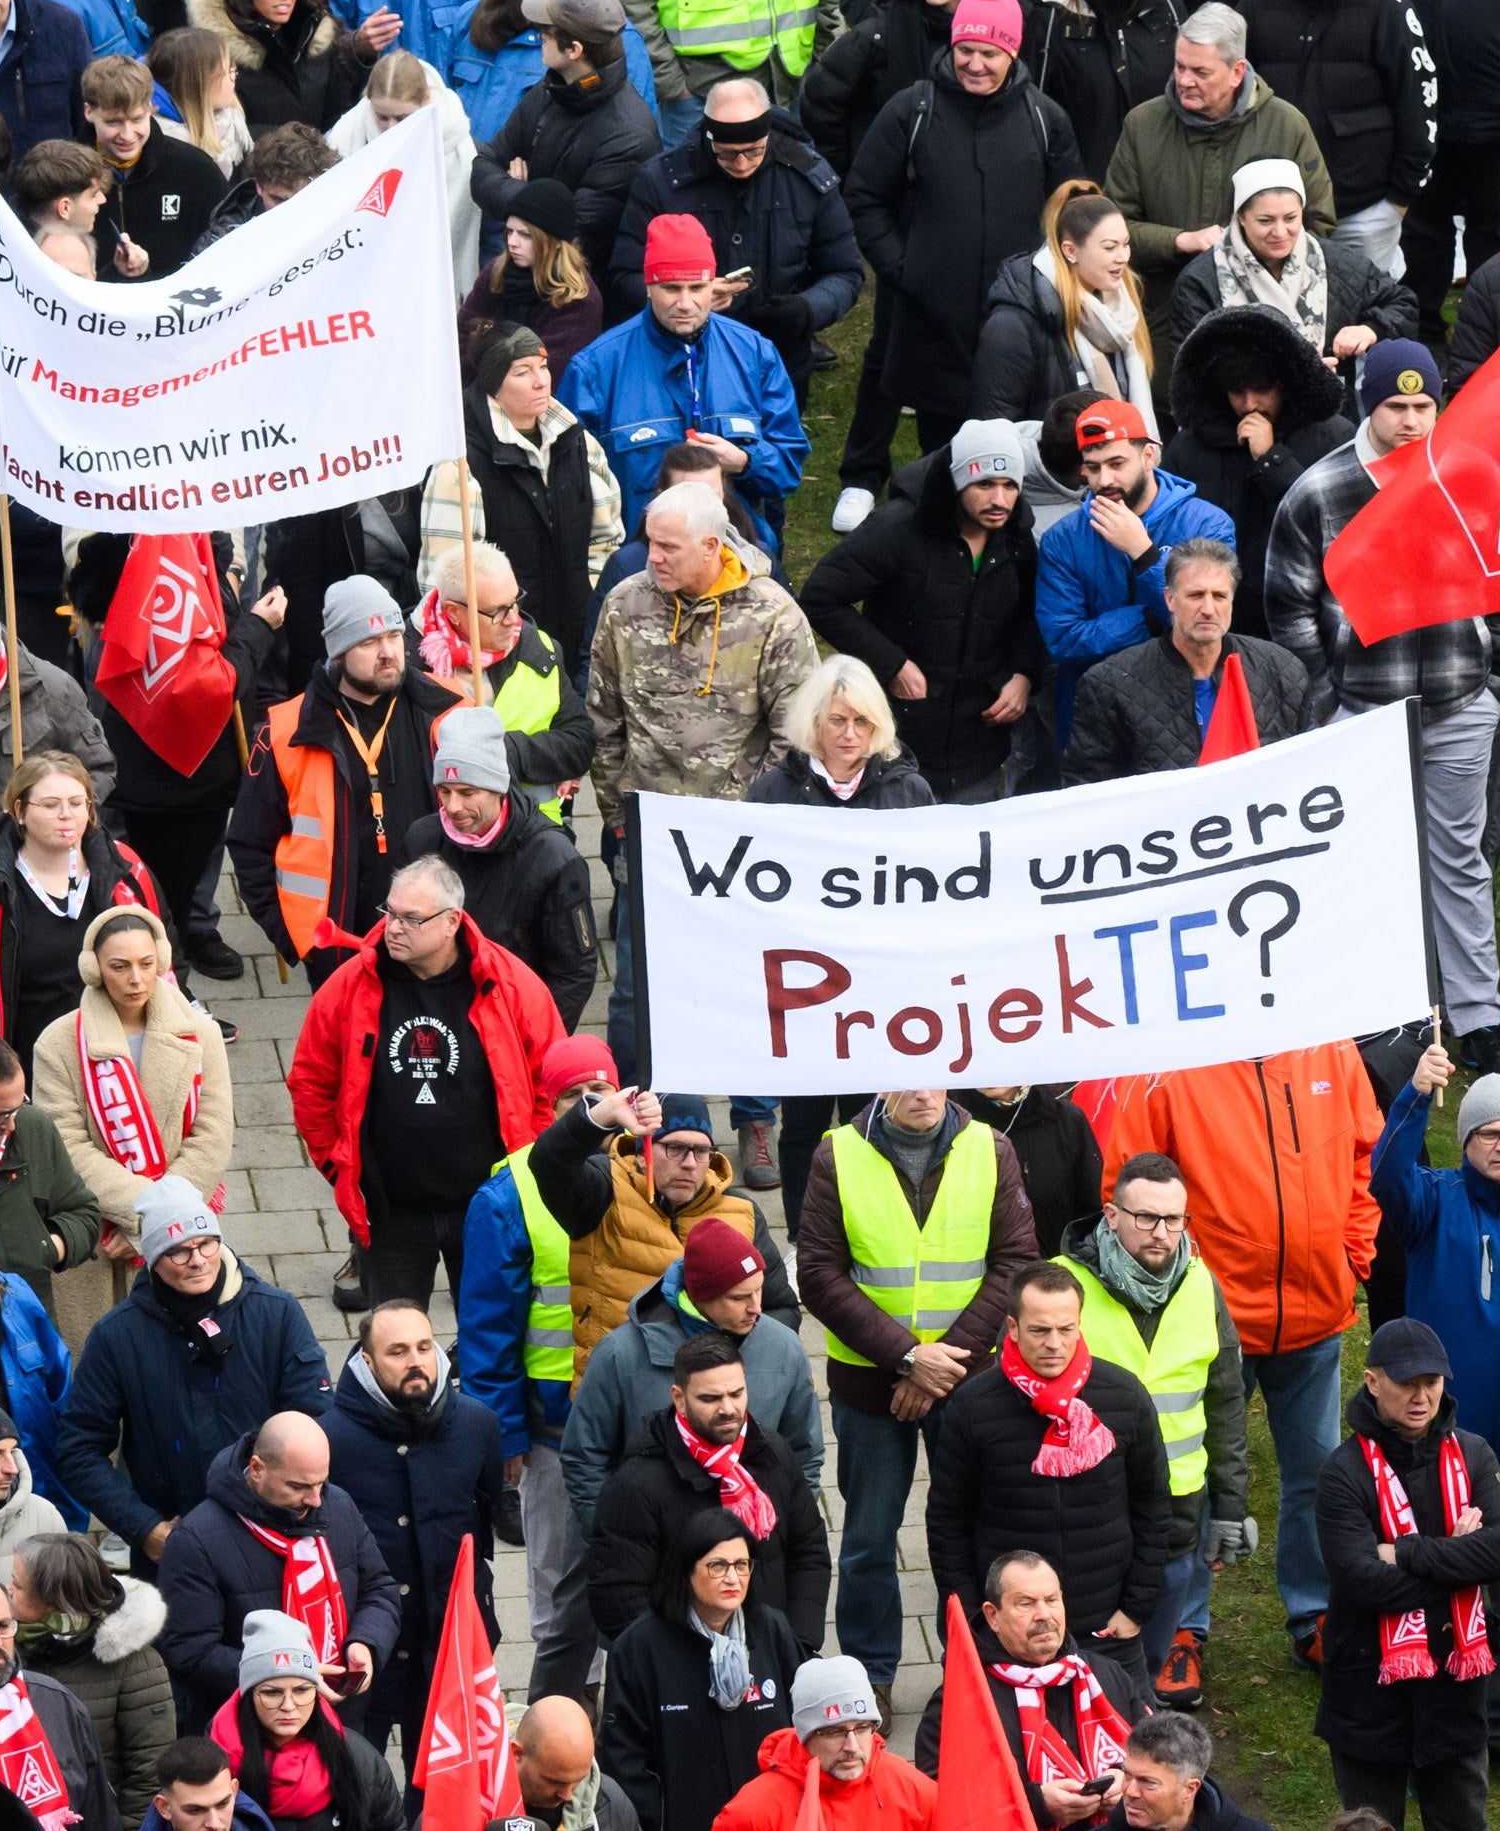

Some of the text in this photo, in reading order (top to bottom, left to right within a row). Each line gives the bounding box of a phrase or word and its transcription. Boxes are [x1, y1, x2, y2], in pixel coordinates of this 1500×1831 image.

[78, 311, 127, 337] die
[268, 225, 365, 298] gesagt:
[31, 310, 376, 407] ManagementFEHLER
[59, 421, 297, 474] können wir nix.
[74, 479, 202, 512] endlich
[211, 454, 308, 503] euren
[317, 434, 404, 482] Job!!!
[668, 784, 1345, 909] Wo sind unsere
